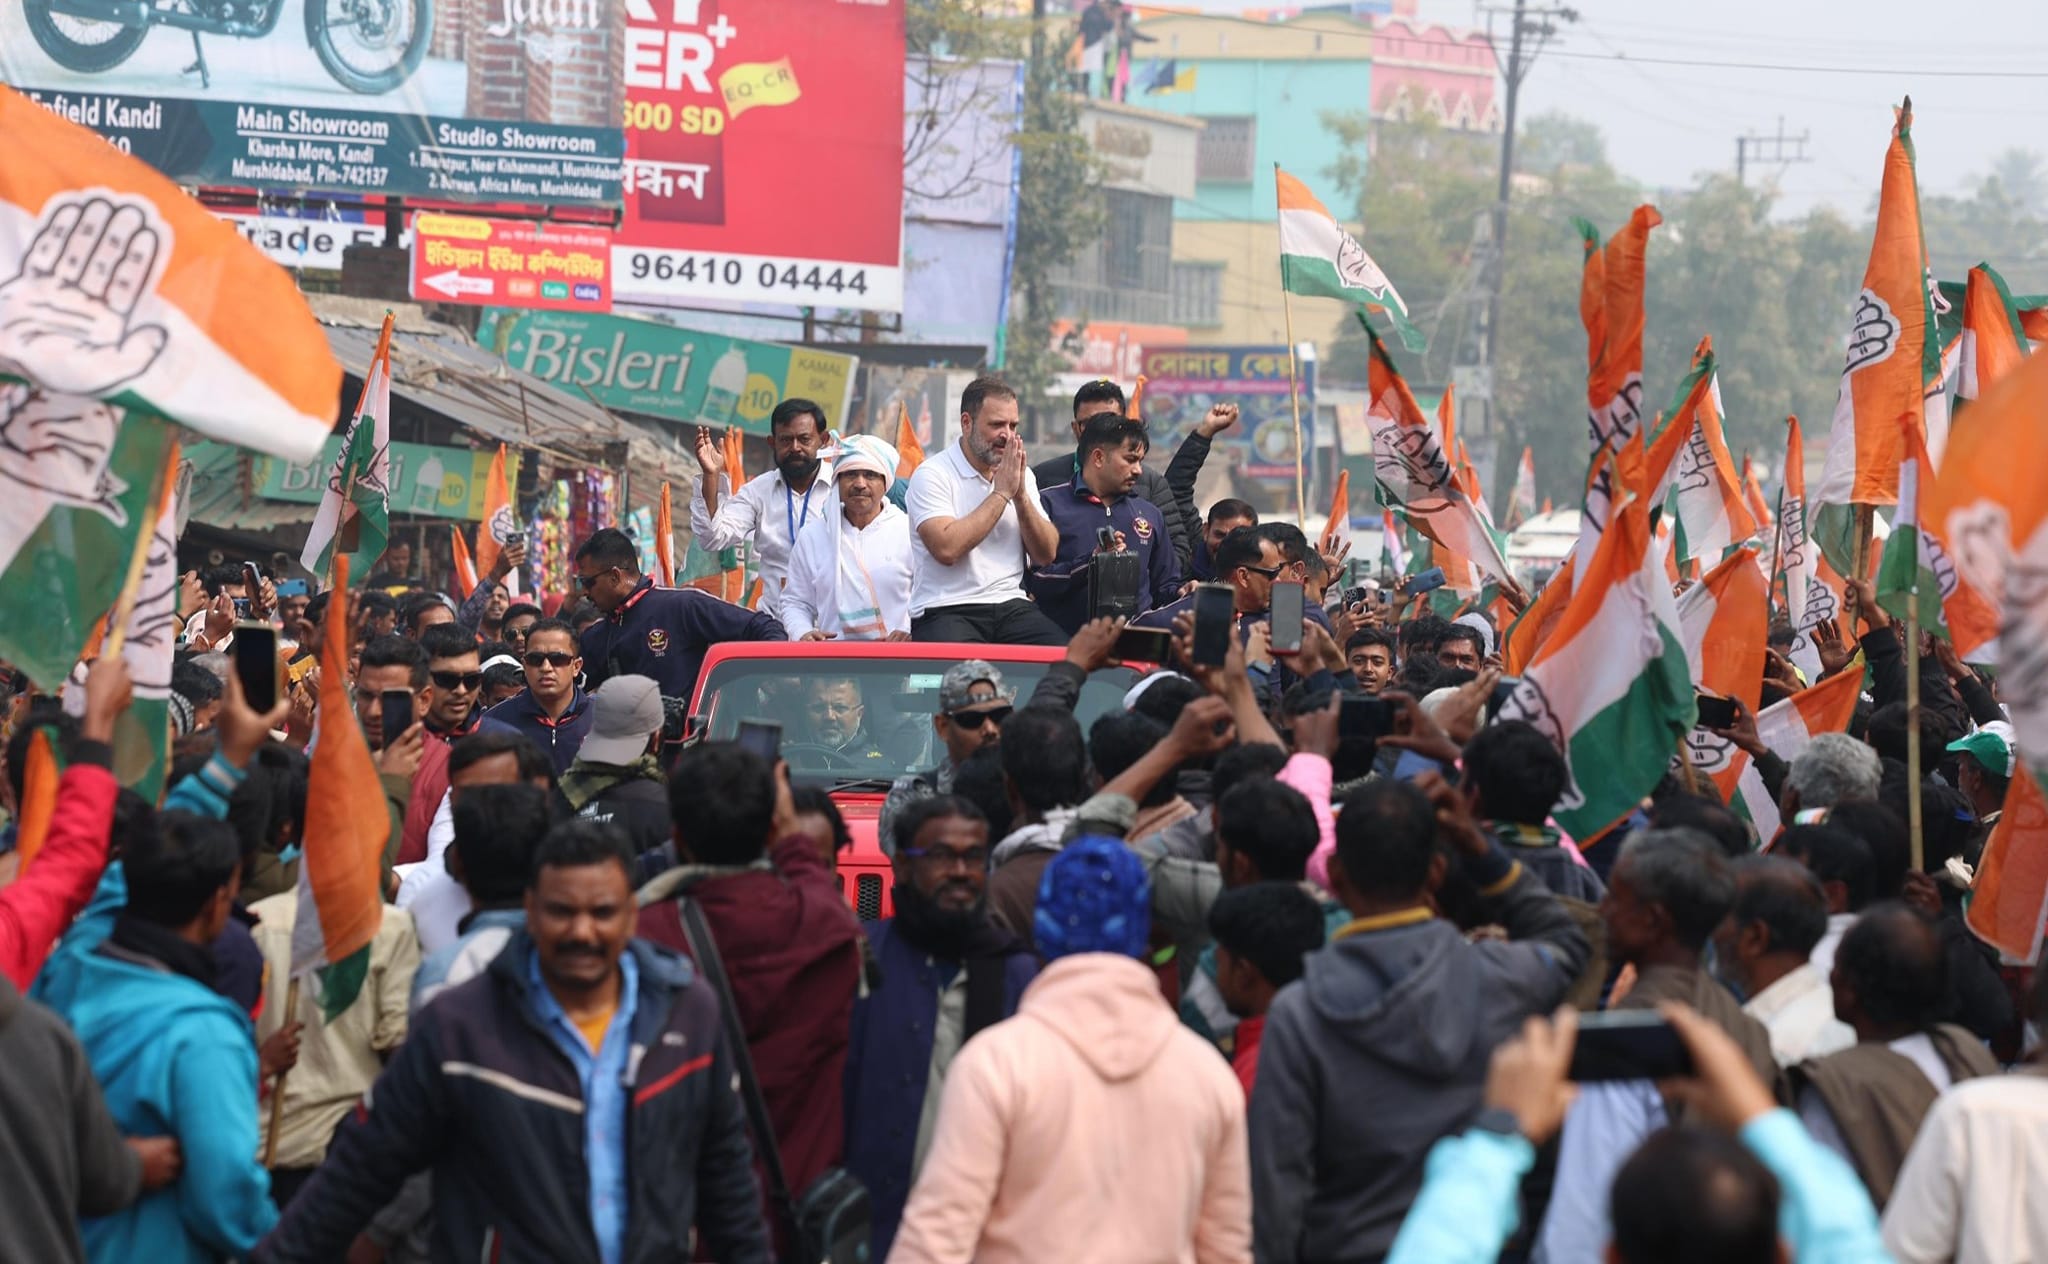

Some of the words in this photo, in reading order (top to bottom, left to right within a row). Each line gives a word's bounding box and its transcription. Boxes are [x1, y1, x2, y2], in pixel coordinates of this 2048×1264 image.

[105, 98, 162, 130] Kandi
[236, 105, 284, 132] Main
[288, 109, 389, 139] Showroom
[680, 105, 724, 136] SD
[247, 137, 296, 160] Kharsha
[298, 141, 336, 164] More,
[338, 143, 374, 164] Kandi
[439, 123, 498, 147] Studio
[502, 127, 596, 154] Showroom
[231, 157, 315, 186] Murshidabad,
[316, 163, 389, 188] Pin-742137
[541, 179, 602, 201] Murshidabad
[631, 253, 742, 285] 96410
[758, 262, 868, 296] 04444
[523, 327, 694, 393] Bisleri
